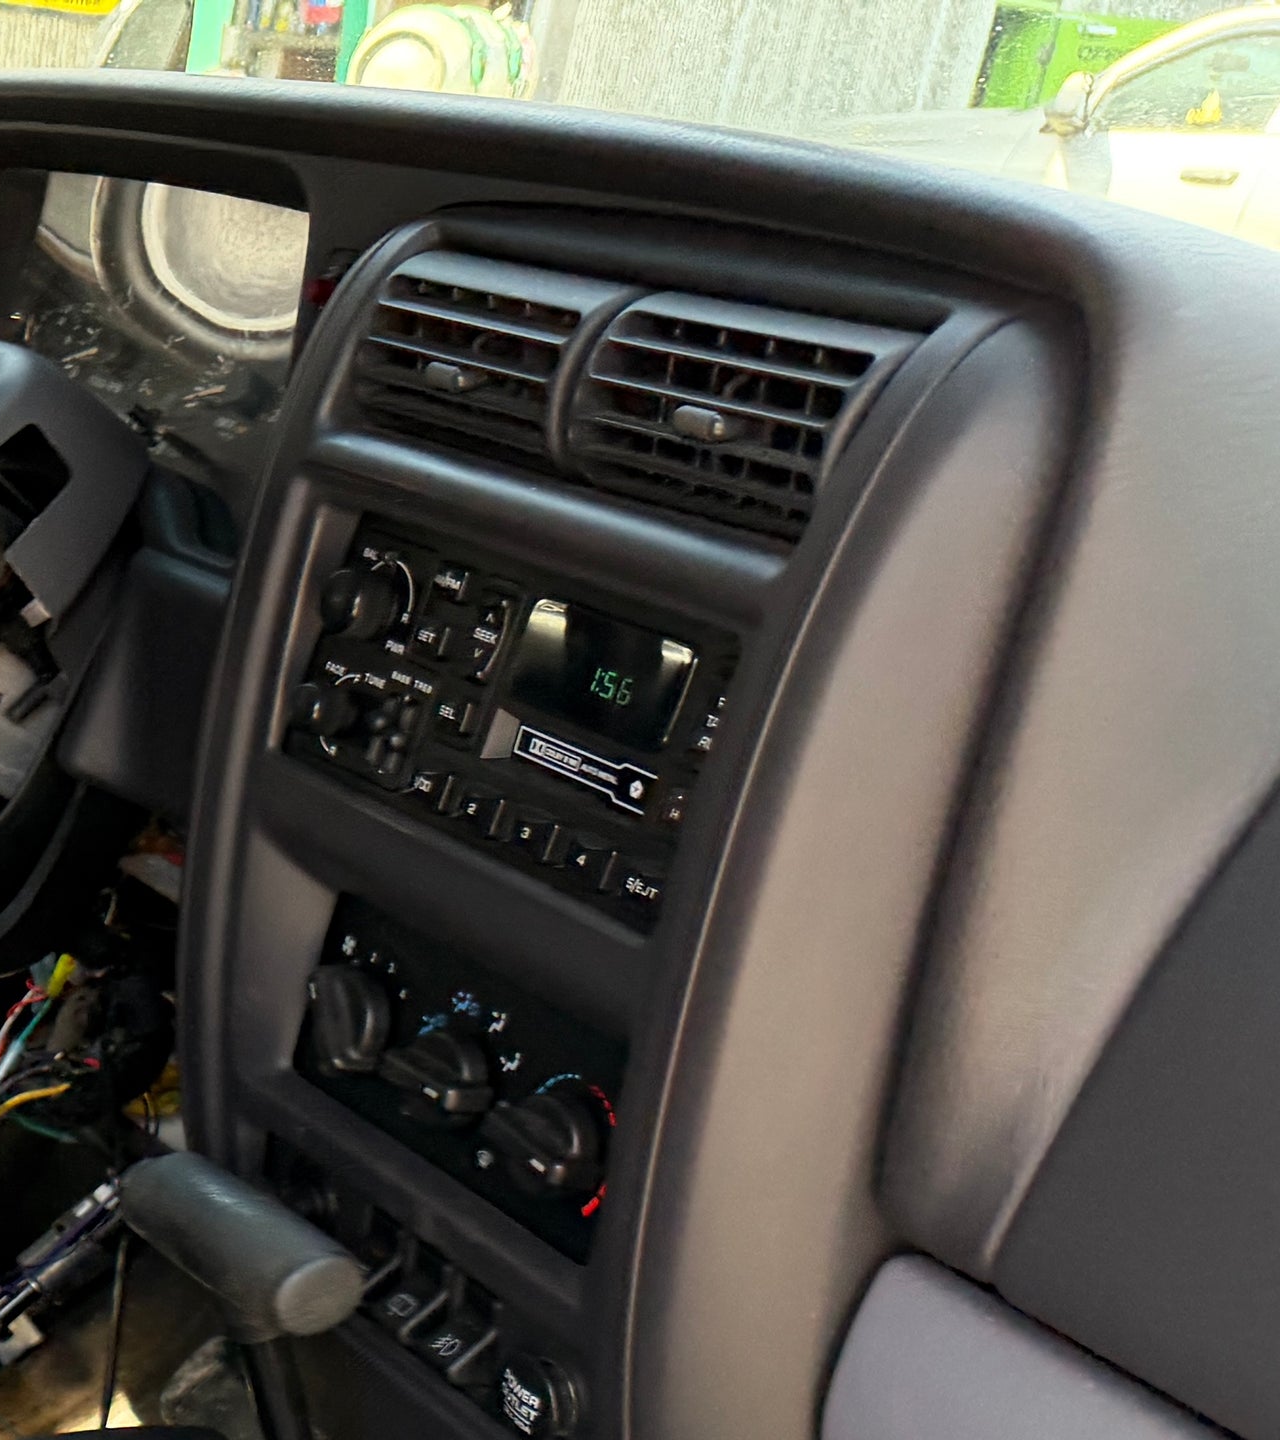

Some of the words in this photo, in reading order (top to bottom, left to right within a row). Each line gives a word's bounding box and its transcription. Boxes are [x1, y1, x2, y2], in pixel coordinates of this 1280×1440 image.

[416, 629, 437, 644] SET
[472, 627, 499, 646] SEEK
[384, 639, 406, 656] PWR
[364, 672, 387, 690] TUNE
[590, 667, 635, 706] 1:56
[438, 704, 456, 721] SEL
[467, 802, 477, 815] 2
[520, 827, 531, 839] 3
[575, 854, 587, 867] 4
